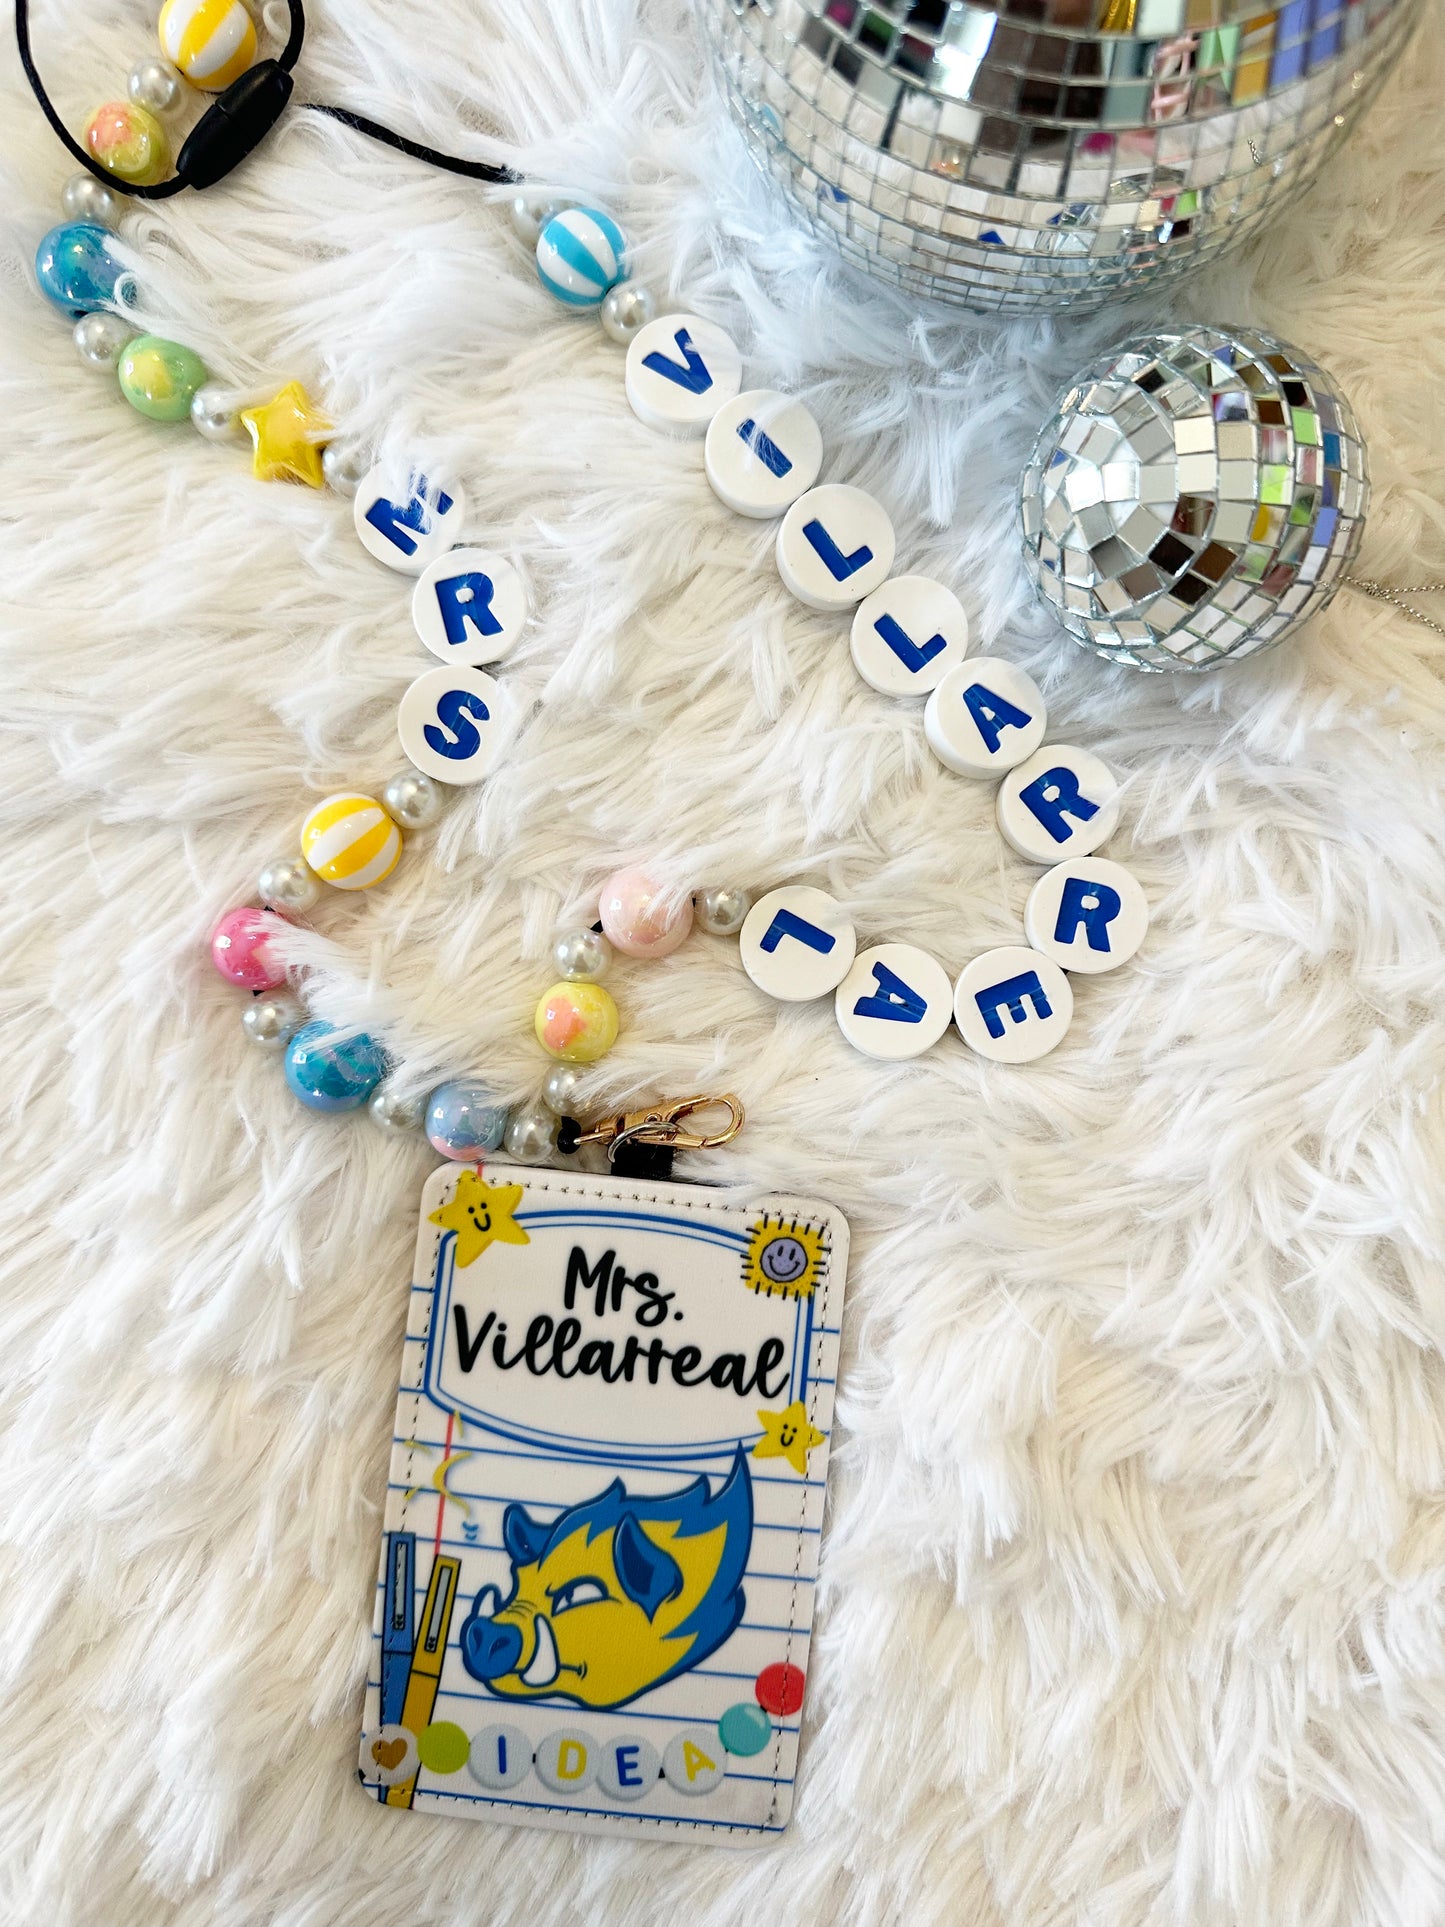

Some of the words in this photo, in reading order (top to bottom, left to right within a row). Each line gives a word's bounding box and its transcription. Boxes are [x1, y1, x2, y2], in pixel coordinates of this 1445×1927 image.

[365, 470, 504, 760] MRS
[641, 327, 1121, 1039] VILLARREAL
[564, 1246, 684, 1327] Mrs.
[453, 1304, 790, 1399] Villarreal
[497, 1734, 716, 1786] IDEA
